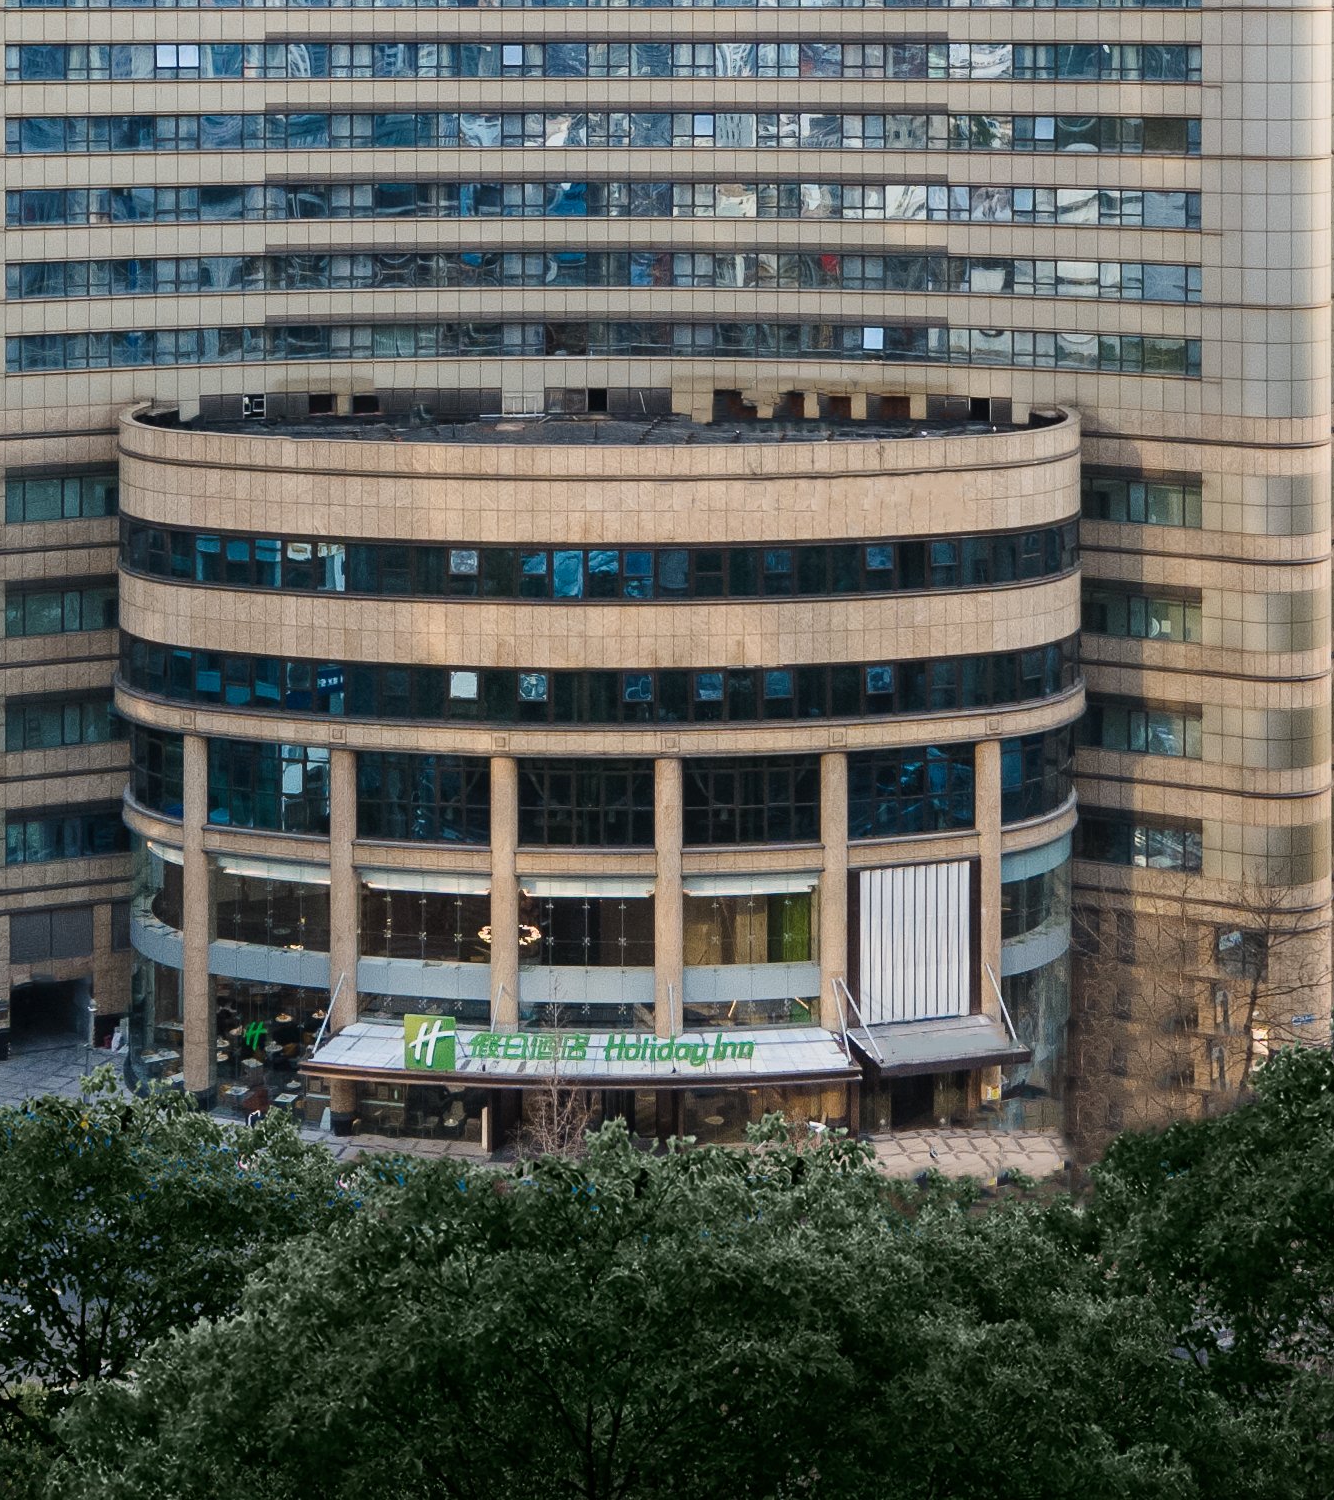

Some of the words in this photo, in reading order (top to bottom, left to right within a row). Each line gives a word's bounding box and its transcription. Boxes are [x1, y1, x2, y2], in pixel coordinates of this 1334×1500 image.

[470, 1032, 590, 1061] 假日酒店
[603, 1034, 708, 1067] Holiday
[713, 1033, 755, 1060] Inn
